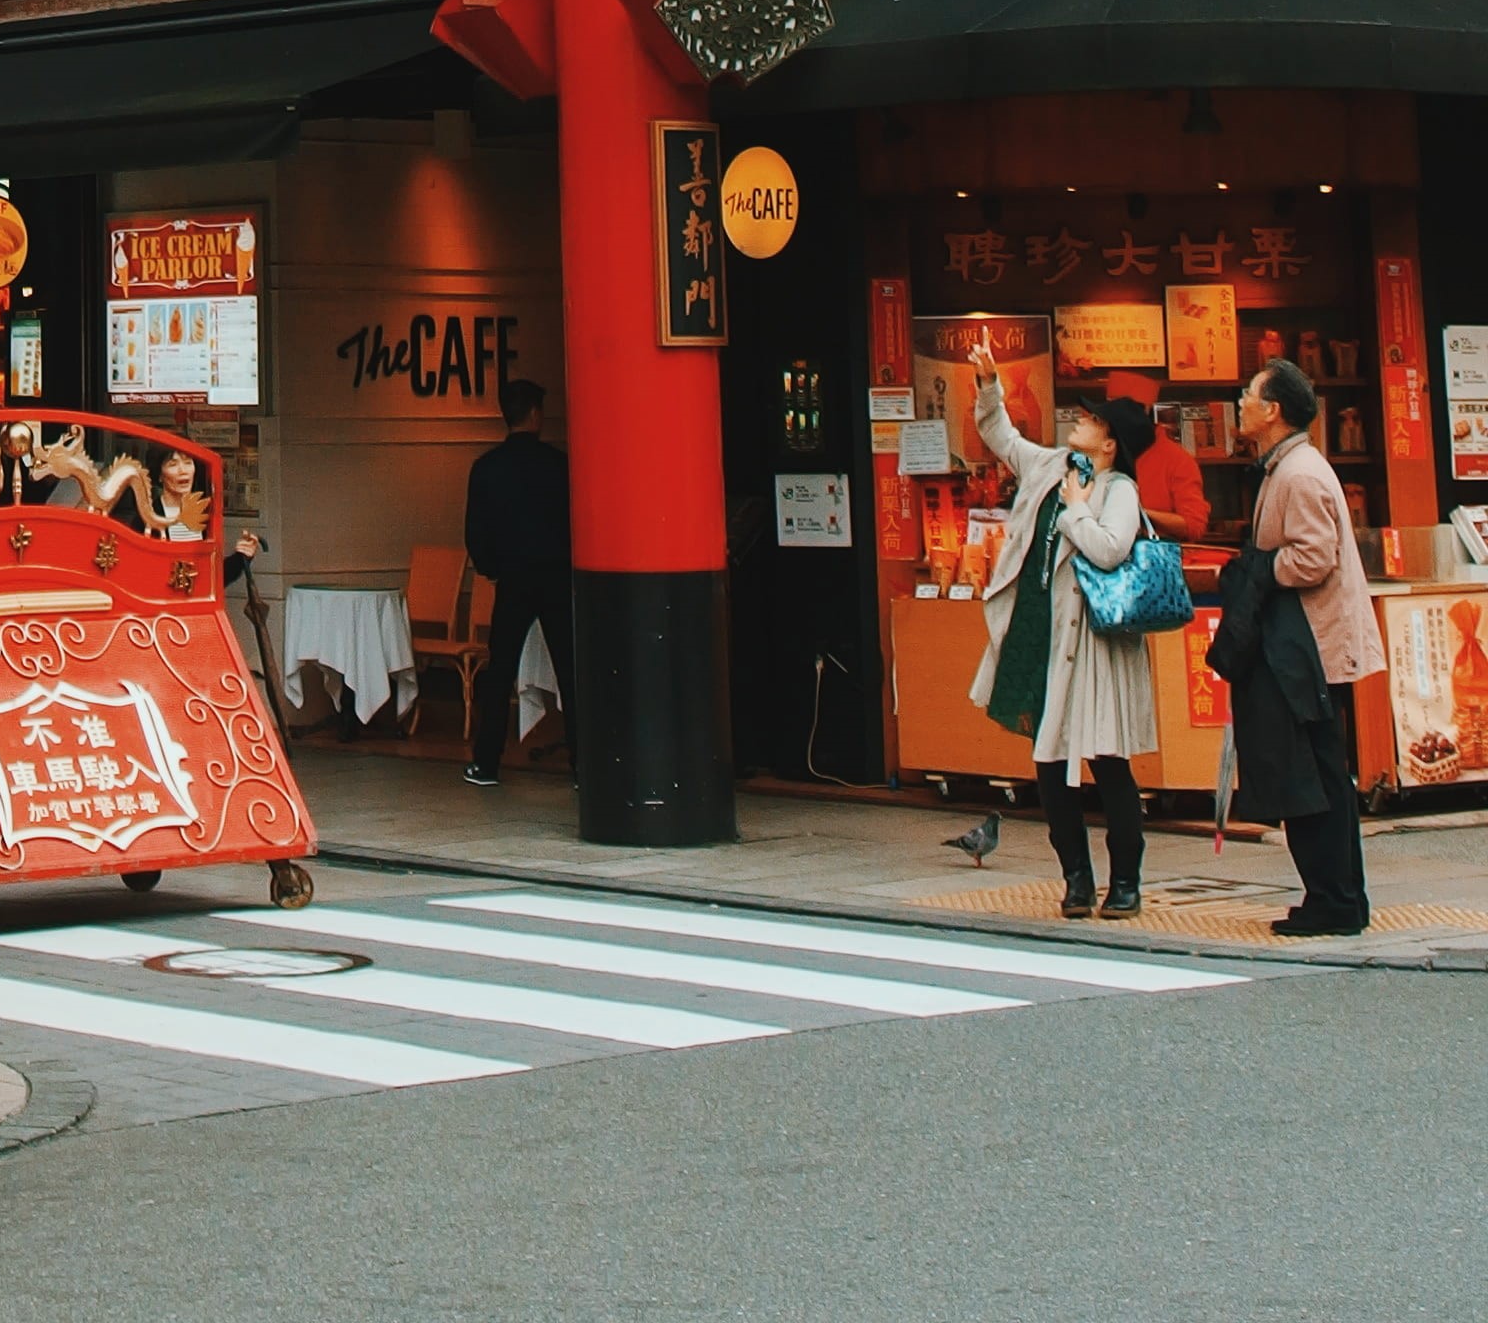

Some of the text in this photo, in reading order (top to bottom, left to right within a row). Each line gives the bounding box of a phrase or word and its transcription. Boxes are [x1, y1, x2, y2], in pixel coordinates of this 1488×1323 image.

[724, 187, 794, 221] The CAFE
[131, 232, 234, 260] ICE CREAM
[141, 256, 224, 282] PARLOR
[337, 324, 412, 389] The
[410, 314, 518, 397] CAFE
[20, 714, 117, 752] 不准
